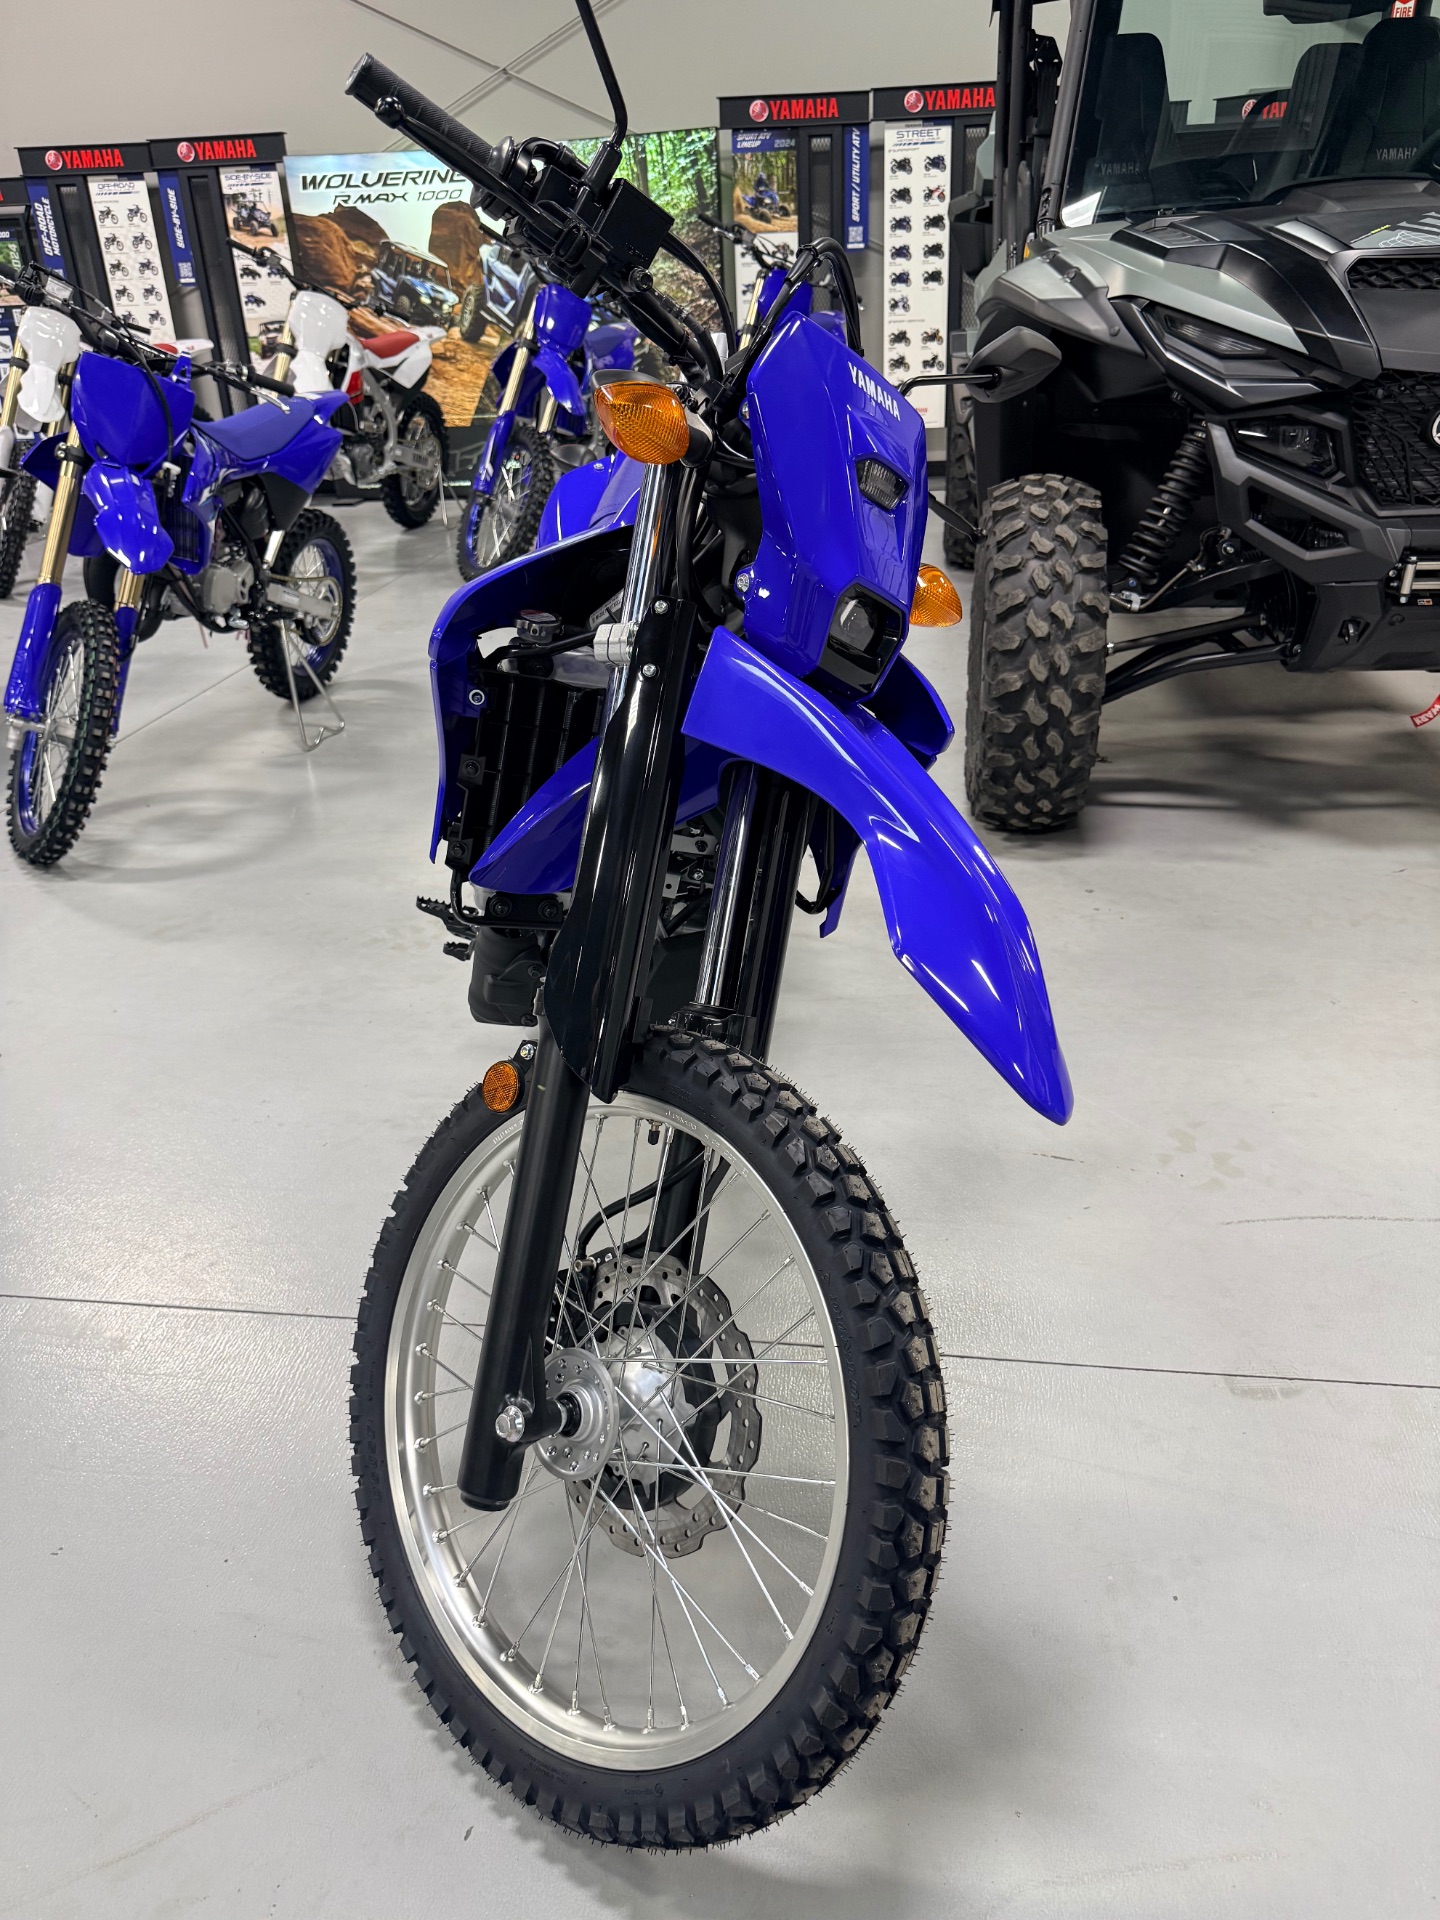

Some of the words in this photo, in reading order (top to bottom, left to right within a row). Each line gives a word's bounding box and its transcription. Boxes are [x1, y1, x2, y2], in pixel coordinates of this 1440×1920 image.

[1395, 7, 1412, 17] FIRE
[769, 98, 839, 120] YAMAHA
[925, 87, 996, 111] YAMAHA
[773, 139, 796, 148] 2024
[852, 128, 861, 148] ATV
[896, 128, 941, 139] STREET
[194, 139, 257, 160] YAMAHA
[736, 140, 762, 148] LINEUP
[62, 149, 124, 169] YAMAHA
[852, 147, 860, 183] UTILITY
[1100, 162, 1140, 175] YAMAHA
[97, 182, 135, 190] OFF-ROAD
[225, 172, 272, 181] SIDE-BY-SIDE
[302, 169, 466, 191] WOLVERINE
[417, 189, 462, 202] 1000
[852, 190, 861, 222] SPORT
[41, 196, 61, 256] MOTORCYCLE
[166, 188, 185, 249] SIDE-BY-SIDE
[34, 202, 53, 256] OFF-ROAD
[848, 361, 901, 421] YAMAHA
